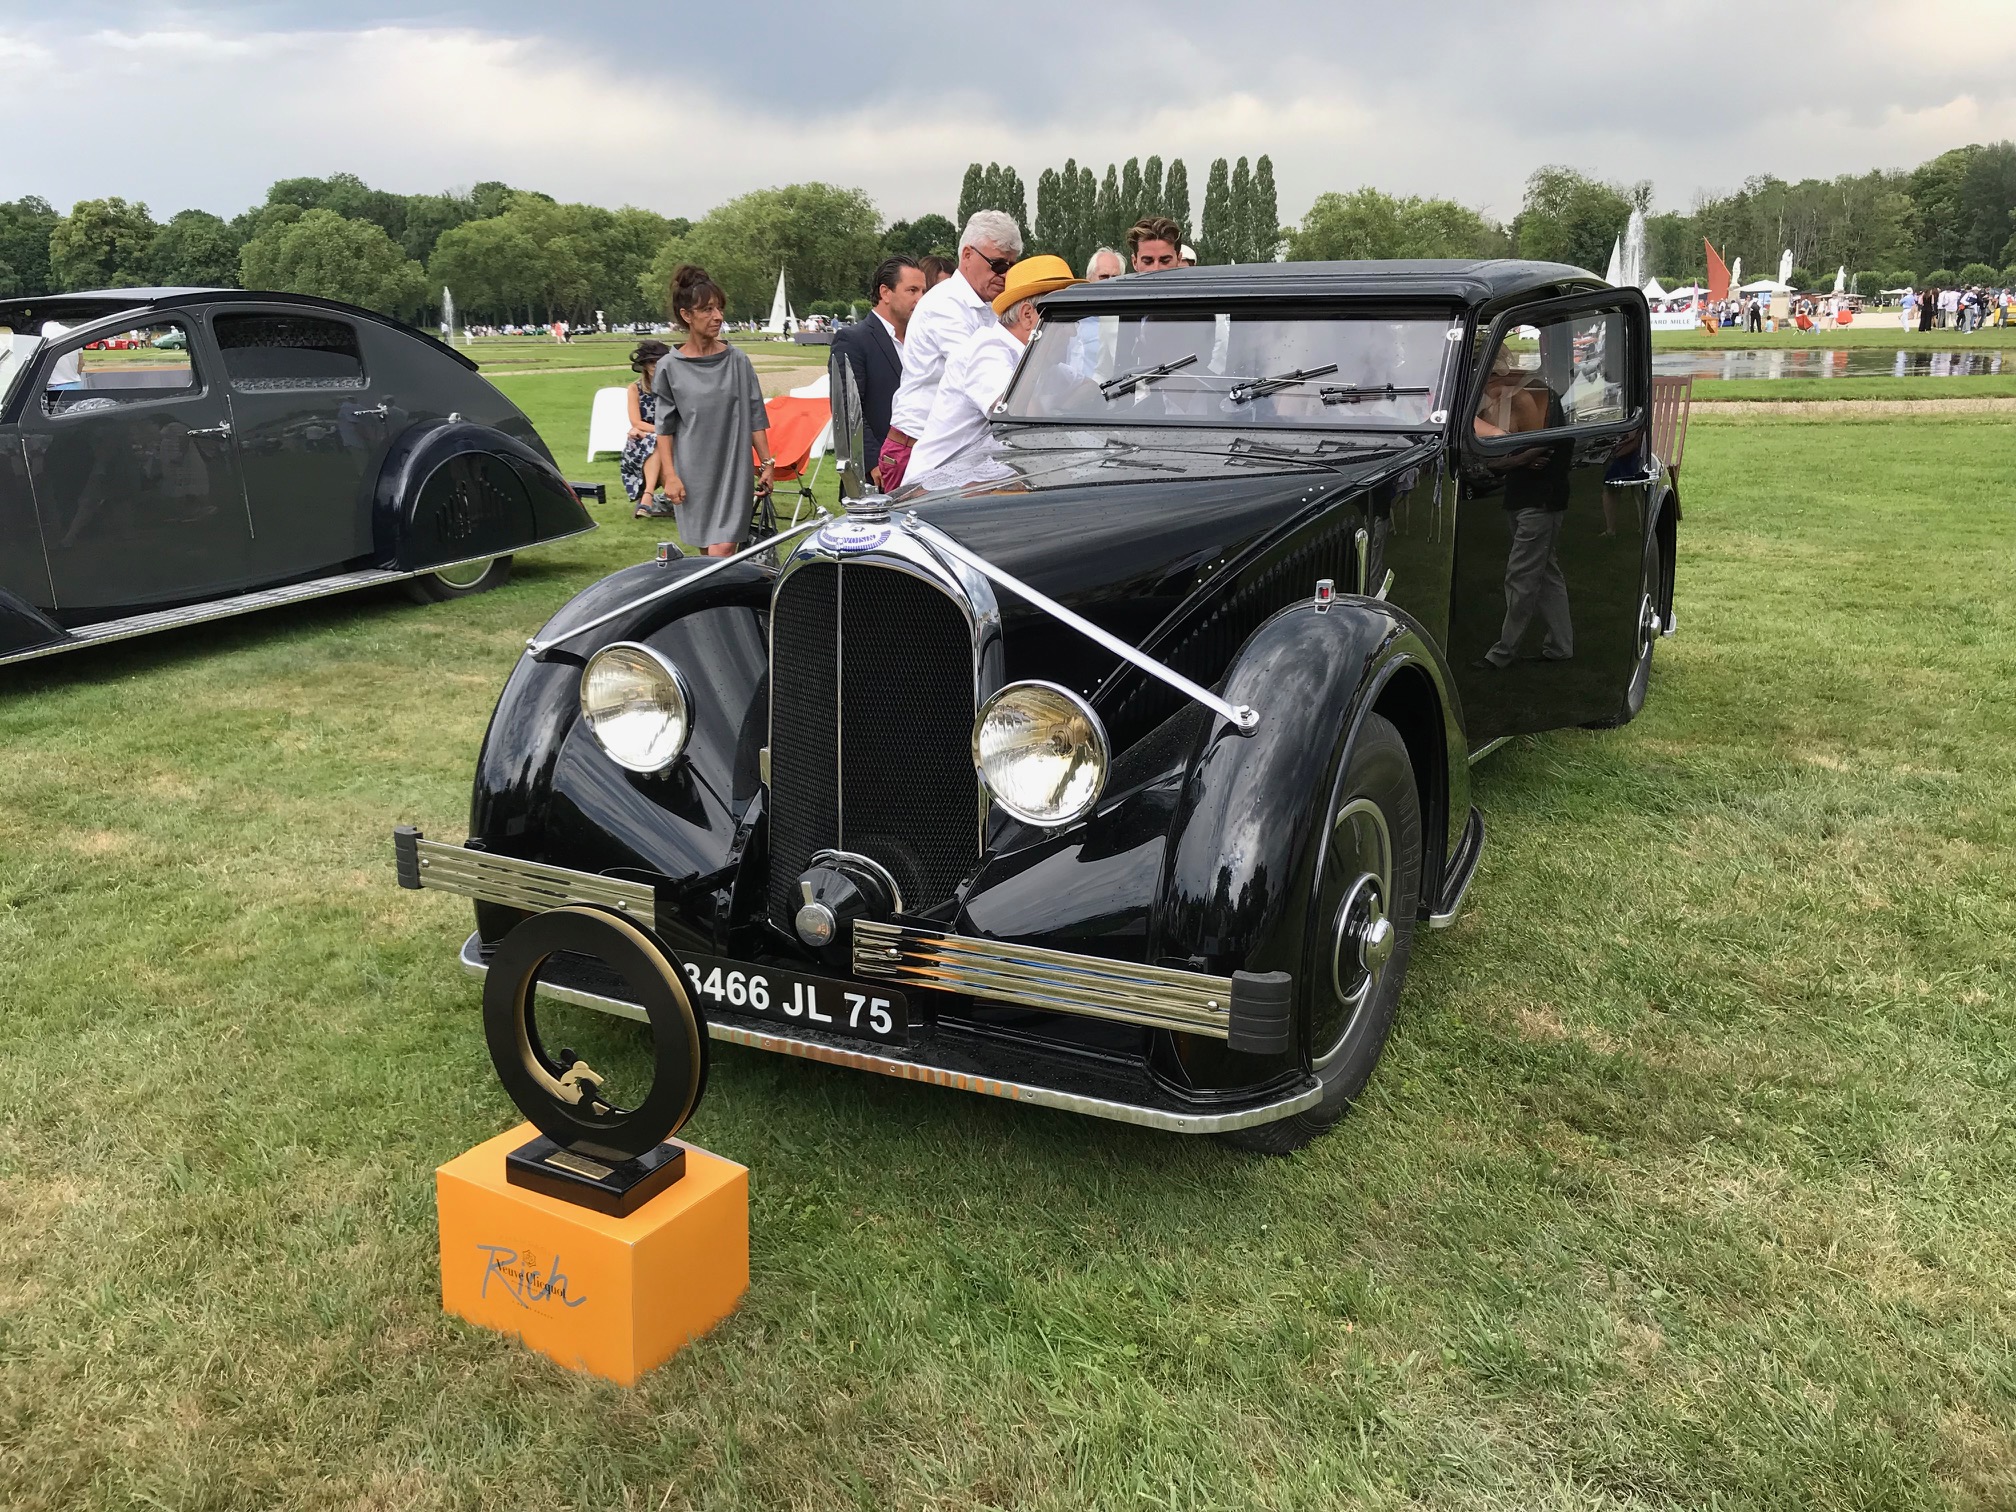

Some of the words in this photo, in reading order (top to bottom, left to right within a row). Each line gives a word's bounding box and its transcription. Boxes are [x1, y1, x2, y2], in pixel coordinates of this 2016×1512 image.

[1396, 786, 1422, 951] MICHELIN
[782, 982, 832, 1023] JL
[843, 992, 893, 1034] 75
[477, 1244, 587, 1309] Rich
[496, 1258, 524, 1279] Veuve
[526, 1271, 566, 1299] Clicquot
